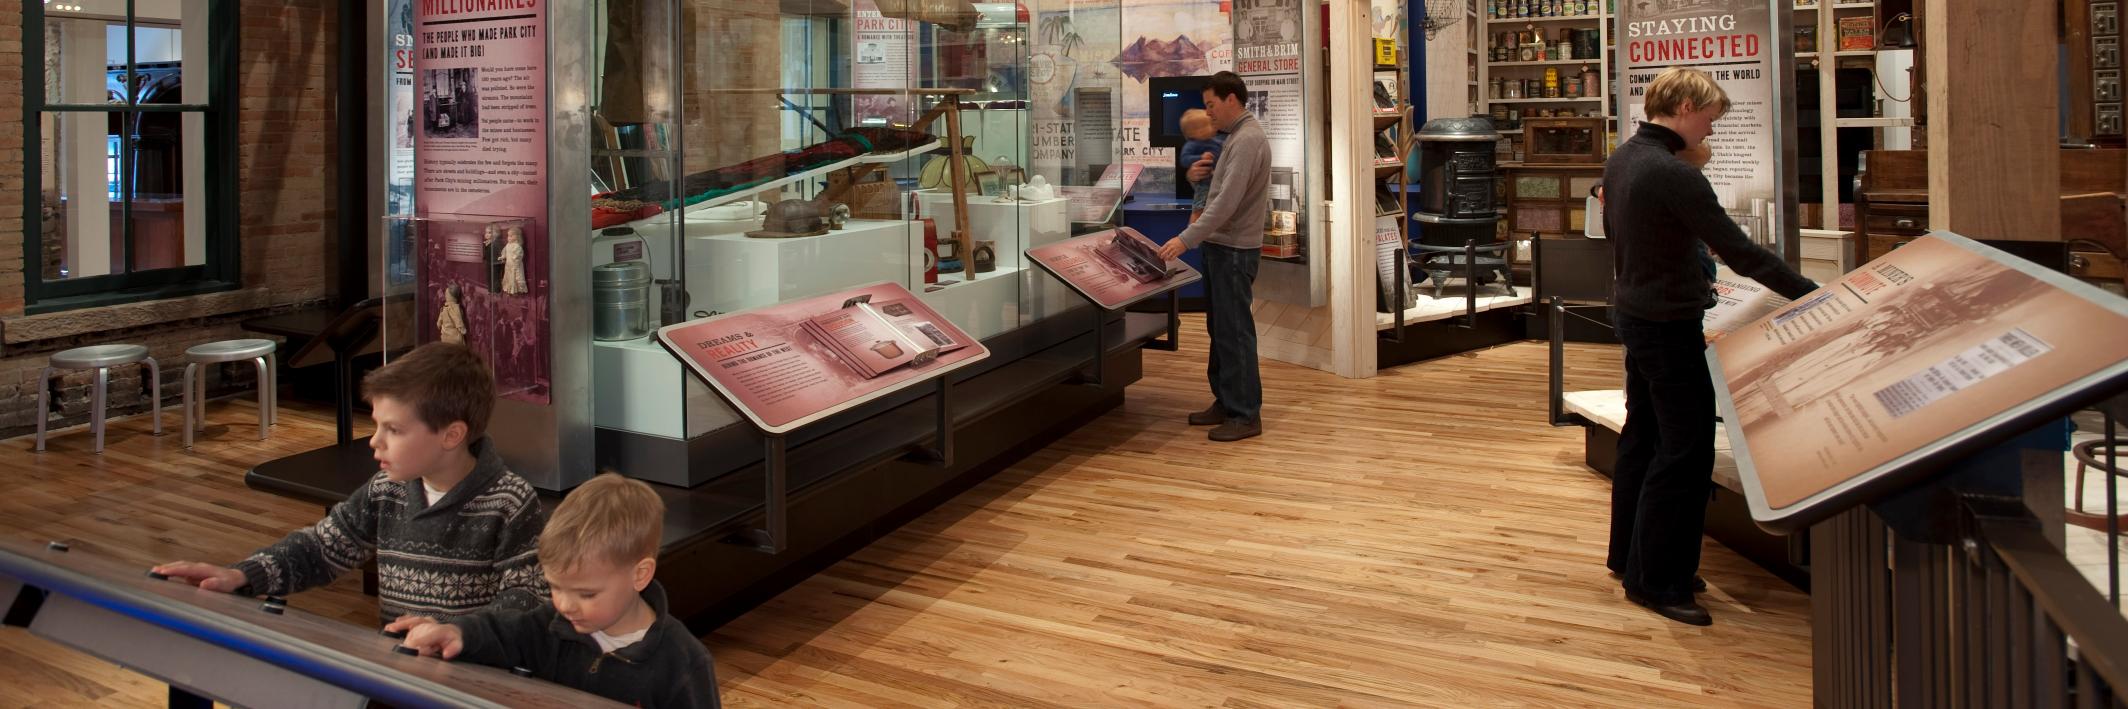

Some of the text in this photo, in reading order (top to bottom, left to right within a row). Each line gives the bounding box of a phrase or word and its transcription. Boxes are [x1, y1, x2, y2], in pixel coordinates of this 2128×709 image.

[857, 18, 913, 30] PARK CITY
[1628, 14, 1736, 37] STAYING
[422, 25, 536, 44] THE PEOPLE WHO MADE PARK CITY
[440, 46, 458, 59] MADE
[461, 46, 467, 58] IT
[1629, 34, 1759, 62] CONNECTED
[1238, 59, 1299, 72] GENERAL STORE
[1716, 71, 1729, 80] THE
[1733, 69, 1760, 80] WORLD
[1630, 86, 1643, 96] AND
[1142, 147, 1164, 155] CITY
[696, 333, 744, 350] DREAMS
[706, 339, 759, 360] REALITY
